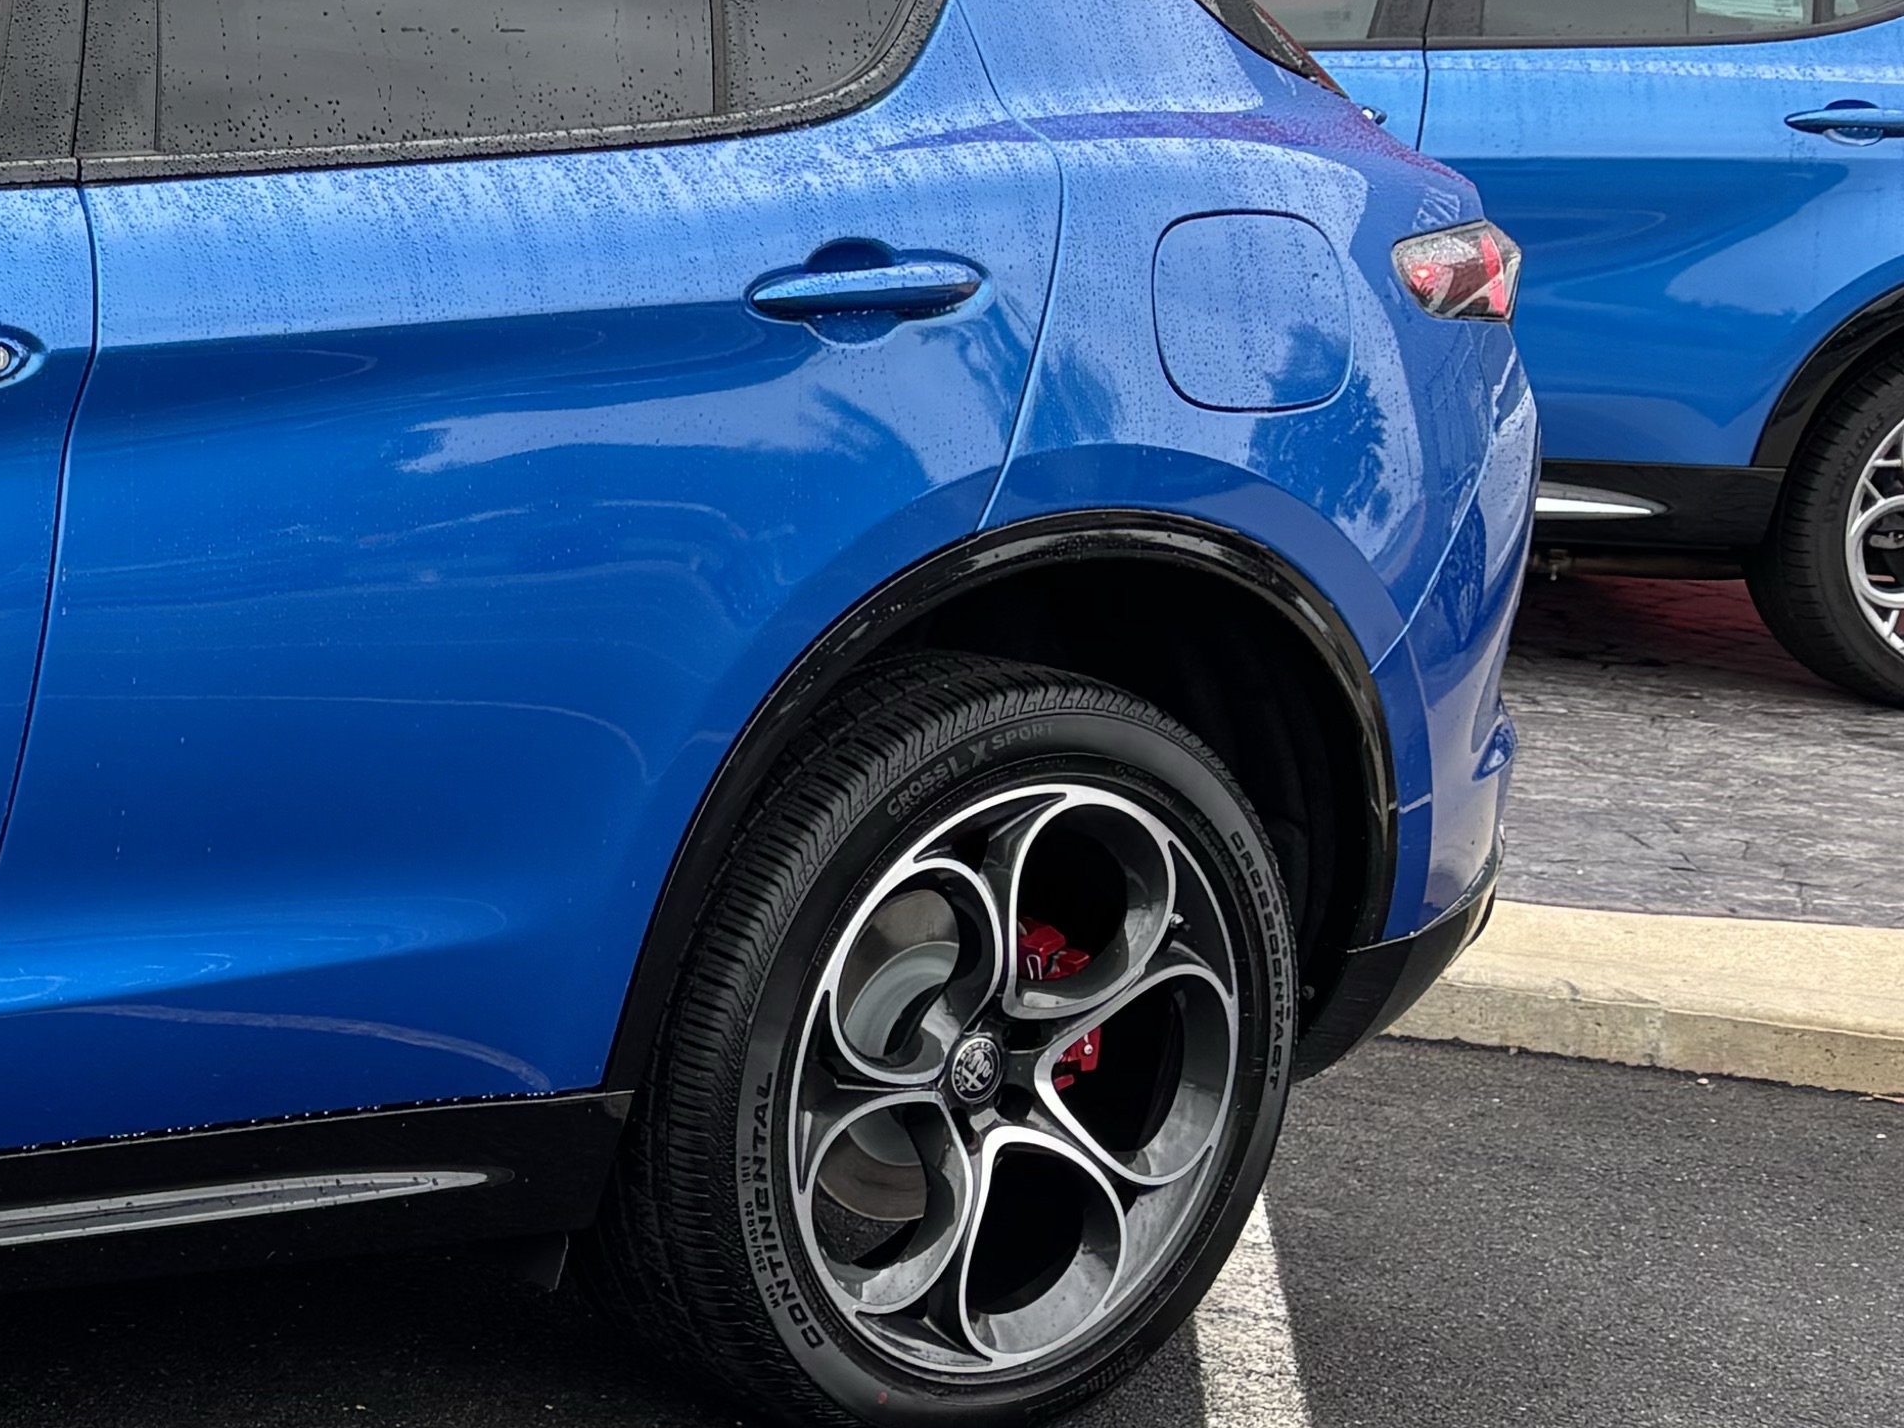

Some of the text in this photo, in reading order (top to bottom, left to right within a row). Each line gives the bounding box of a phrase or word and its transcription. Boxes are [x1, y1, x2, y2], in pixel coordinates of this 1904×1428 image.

[887, 763, 951, 816] CROSS
[992, 722, 1054, 750] SPORT
[752, 1072, 825, 1350] CONTINENTAL
